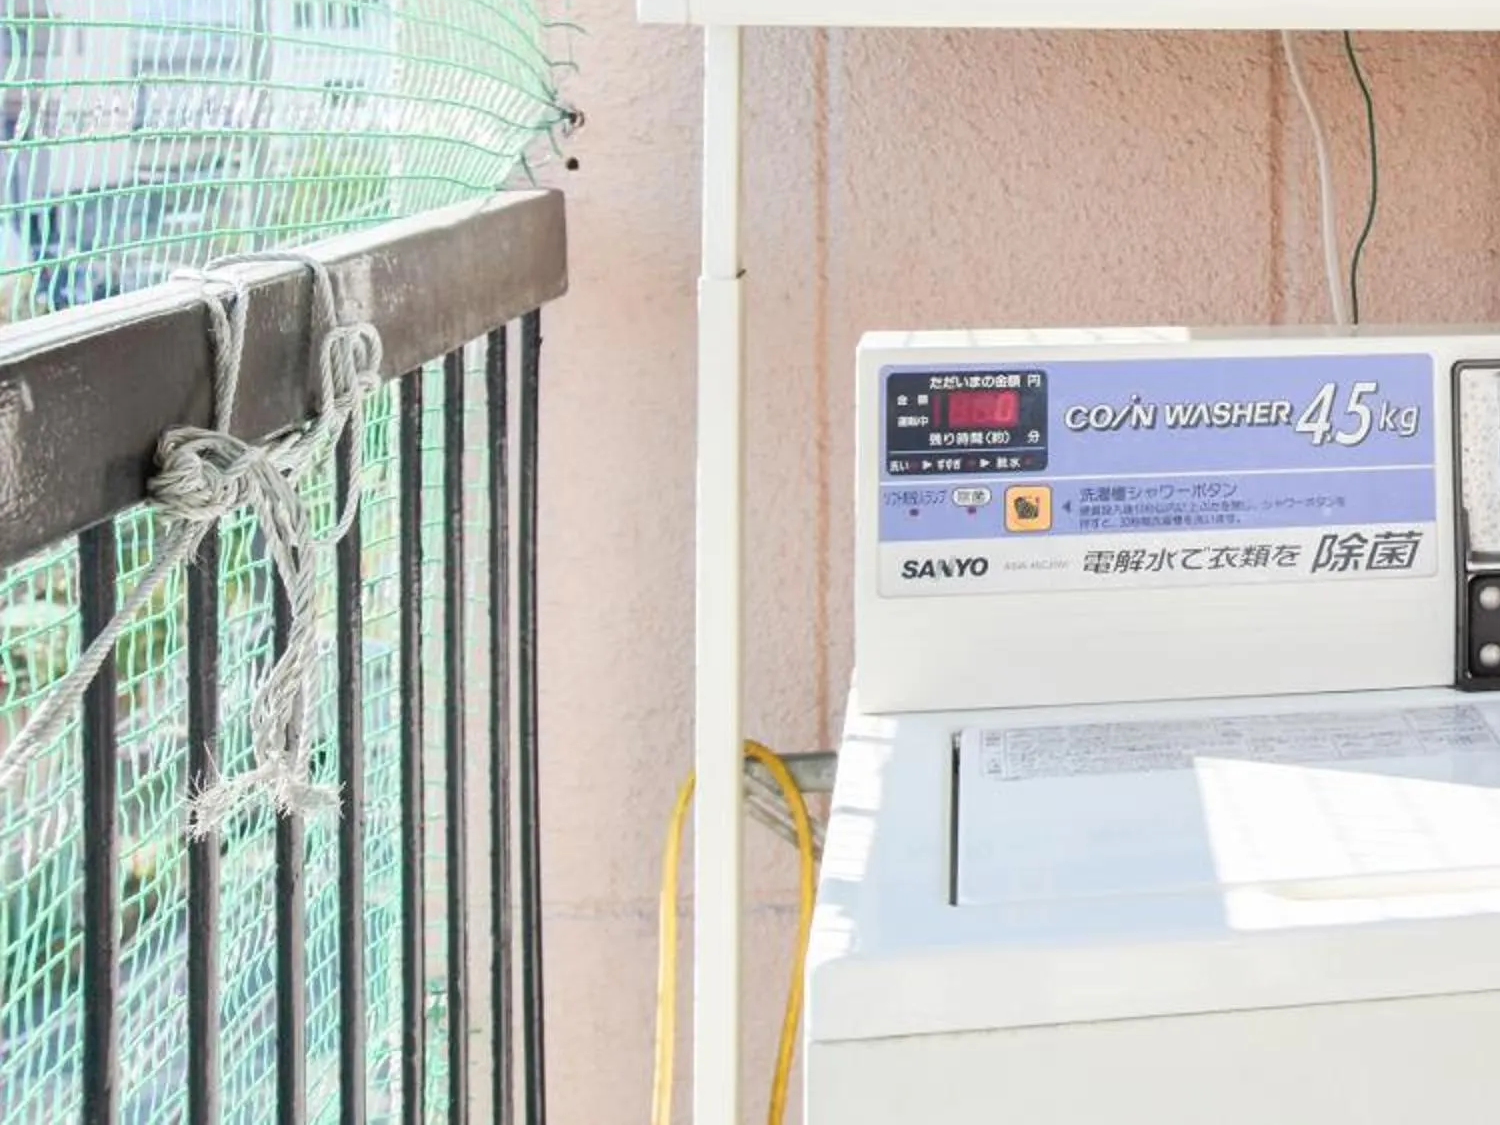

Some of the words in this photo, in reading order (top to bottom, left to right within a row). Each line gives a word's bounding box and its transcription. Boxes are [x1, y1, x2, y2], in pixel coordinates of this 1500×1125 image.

[929, 374, 1021, 390] ただいまの金額
[1027, 373, 1041, 387] 円
[1163, 398, 1294, 427] WASHER
[1026, 429, 1041, 444] 分
[1082, 543, 1301, 575] 電解水で衣類を
[1310, 529, 1423, 574] 除菌
[901, 556, 989, 579] SANYO
